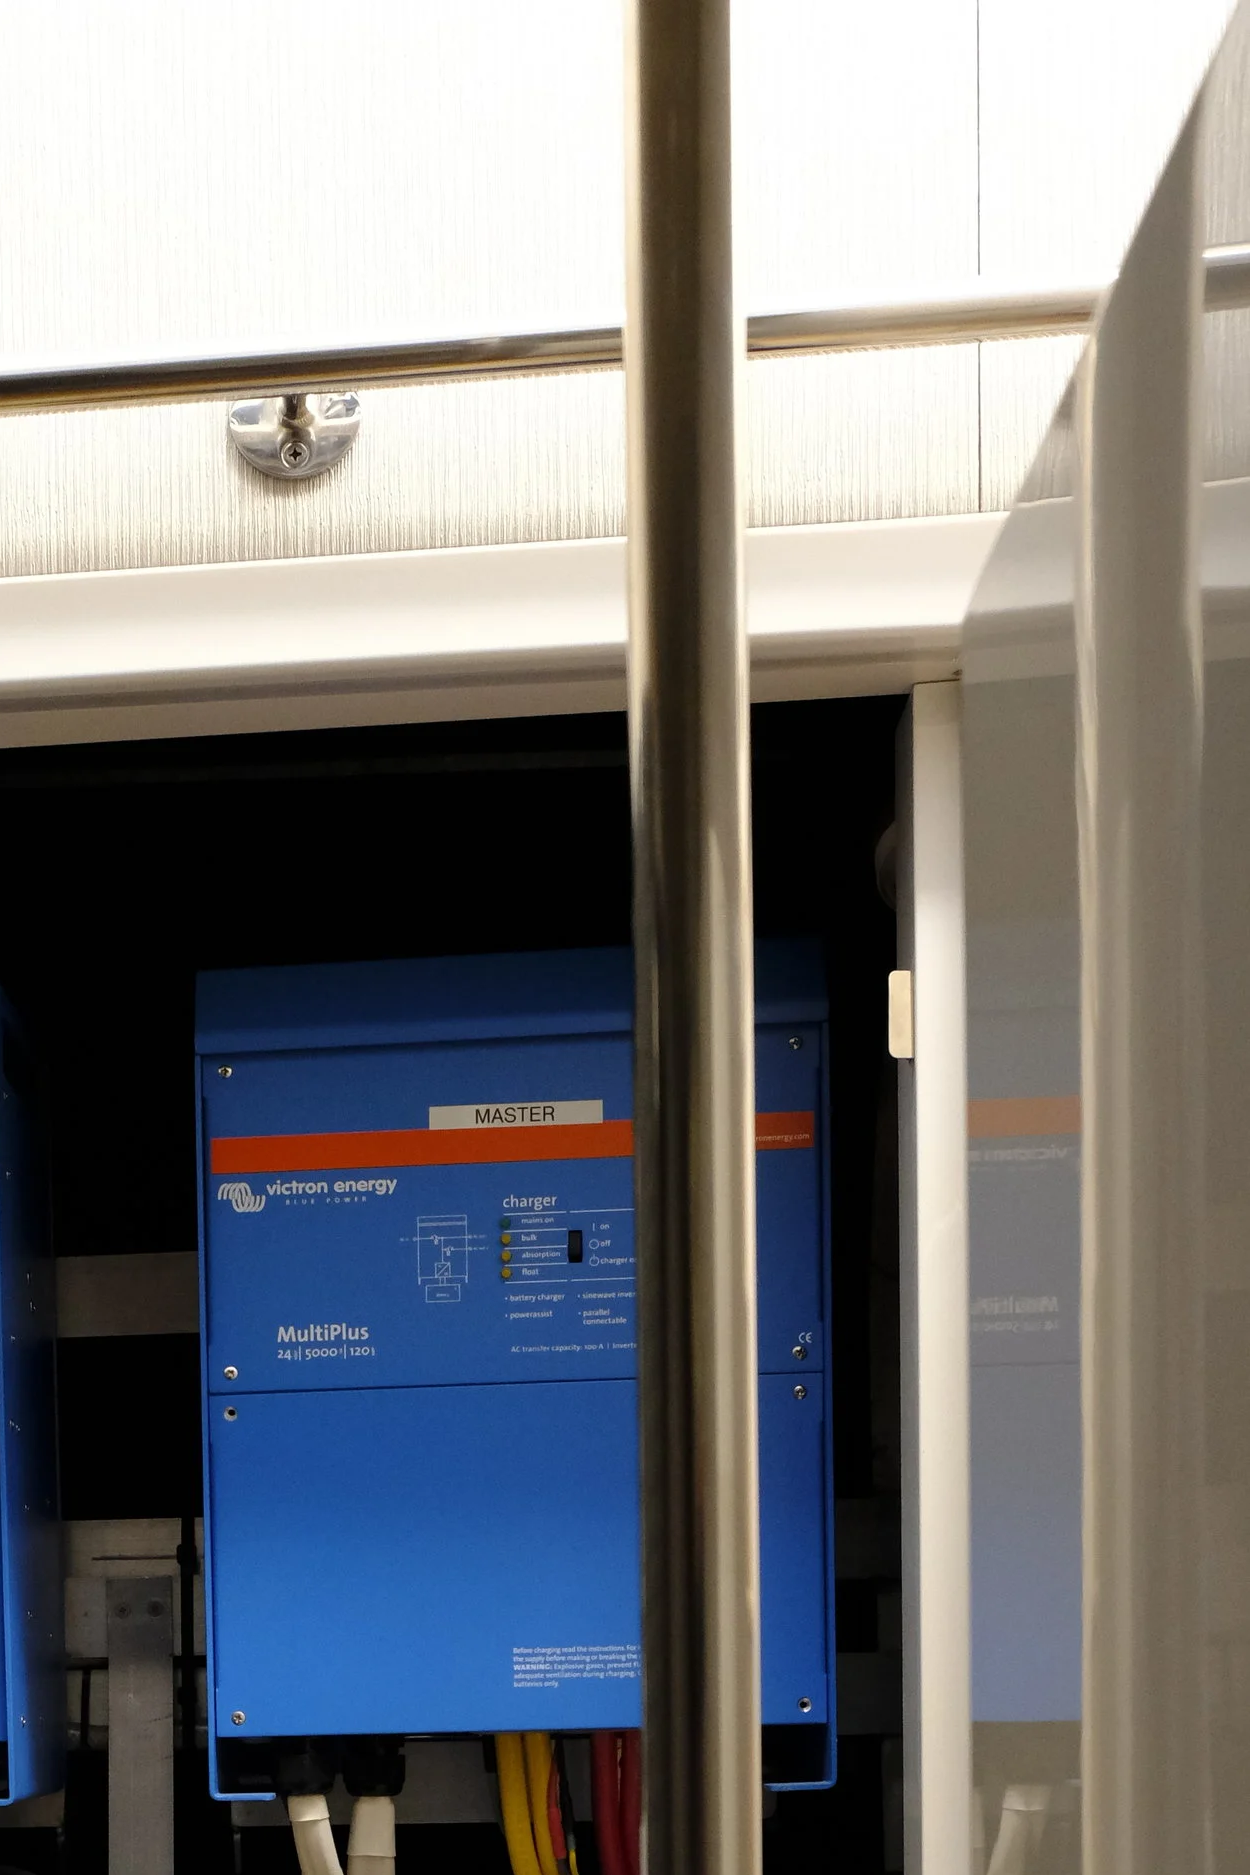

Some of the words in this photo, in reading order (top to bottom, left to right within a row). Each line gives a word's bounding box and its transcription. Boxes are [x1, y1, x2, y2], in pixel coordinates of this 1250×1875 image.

[475, 1105, 555, 1125] MASTER
[755, 1132, 810, 1143] ronenergy.com
[266, 1180, 328, 1197] victron
[334, 1178, 398, 1196] energy
[285, 1198, 316, 1206] BLUE
[327, 1196, 368, 1204] POWER
[503, 1194, 557, 1210] charger
[522, 1251, 561, 1259] absorption
[277, 1322, 369, 1343] MultiPlus
